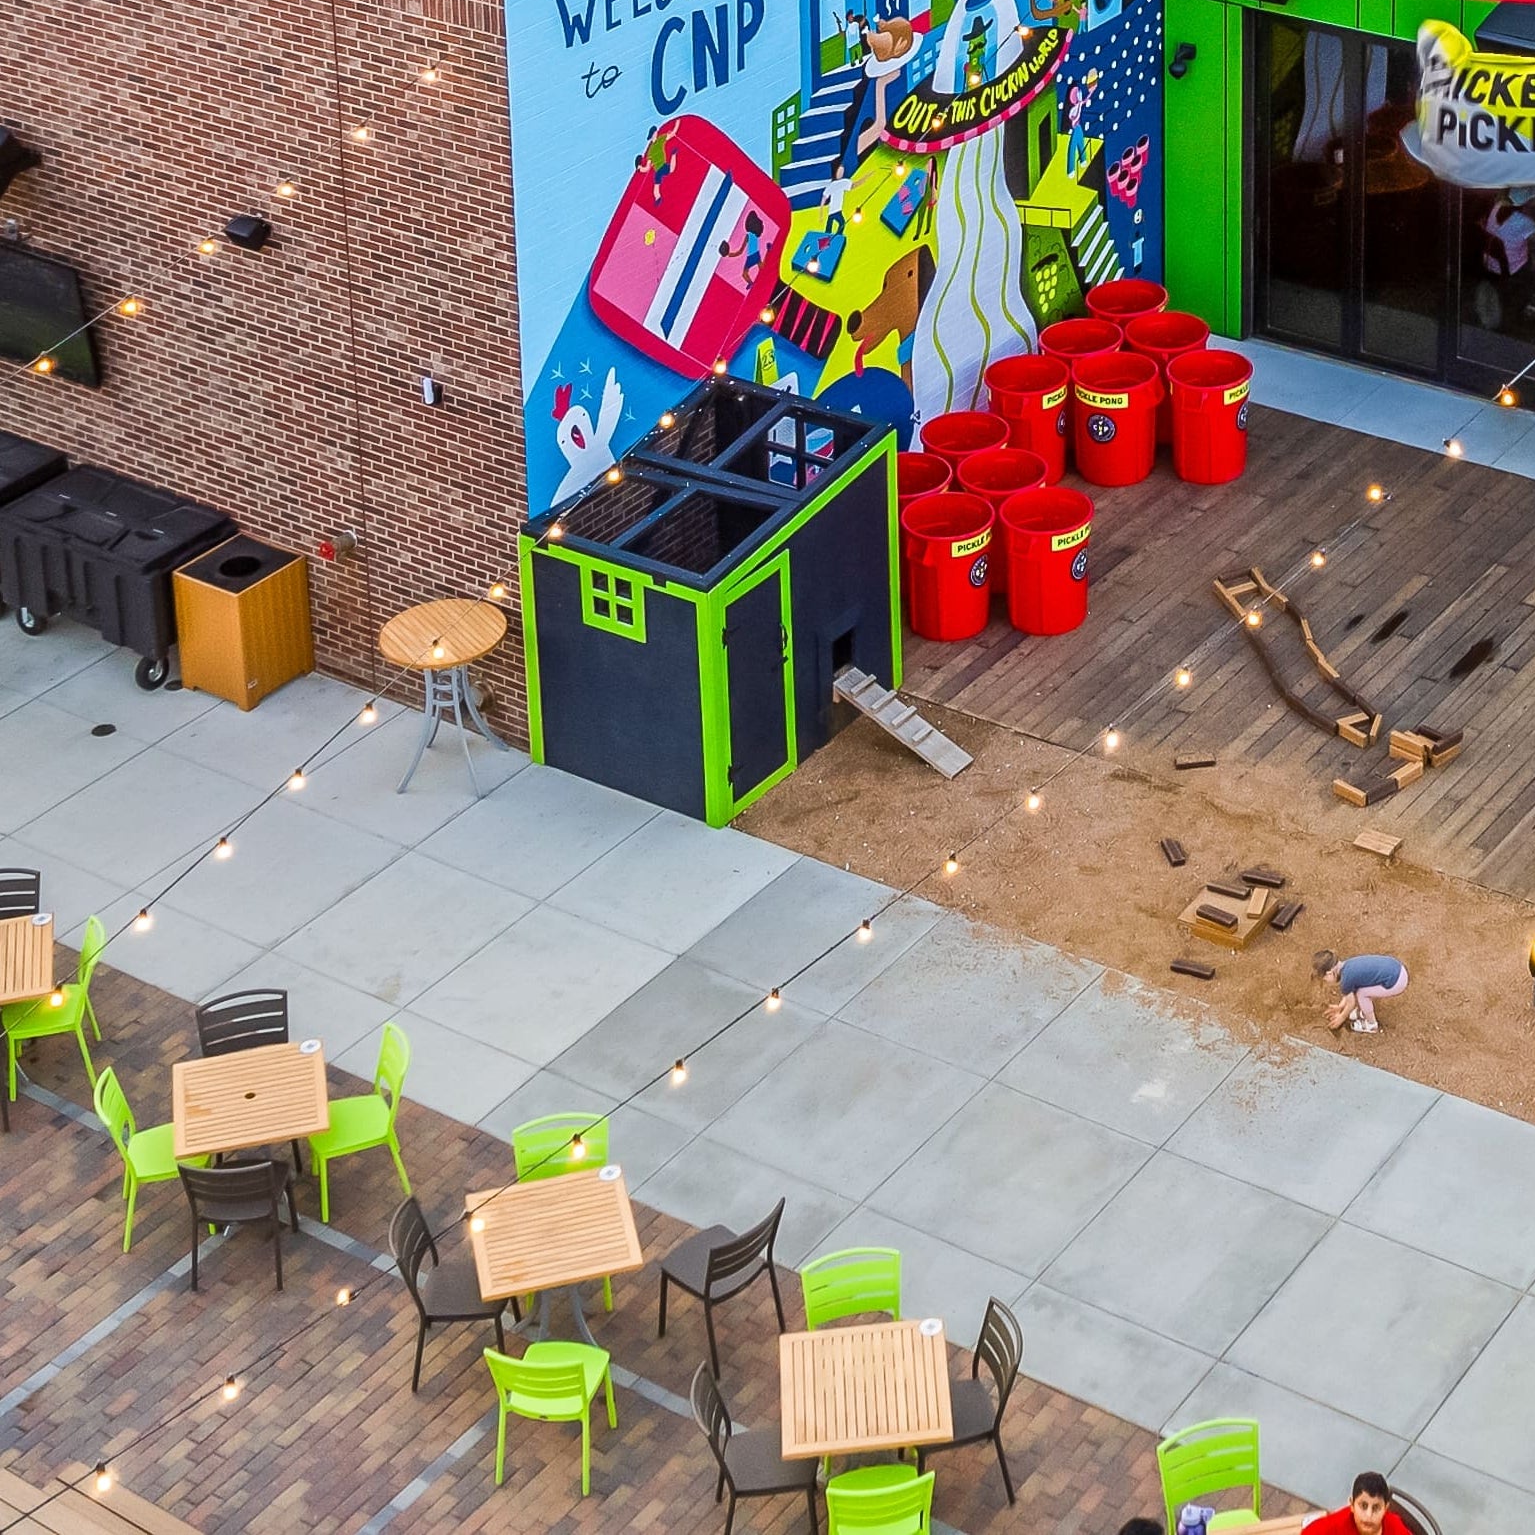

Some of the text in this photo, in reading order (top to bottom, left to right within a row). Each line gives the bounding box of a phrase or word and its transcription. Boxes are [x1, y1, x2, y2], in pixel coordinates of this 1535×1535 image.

[581, 61, 623, 99] to
[893, 94, 937, 134] OUT
[951, 97, 976, 124] THIS
[980, 63, 1029, 117] CLUCKIN
